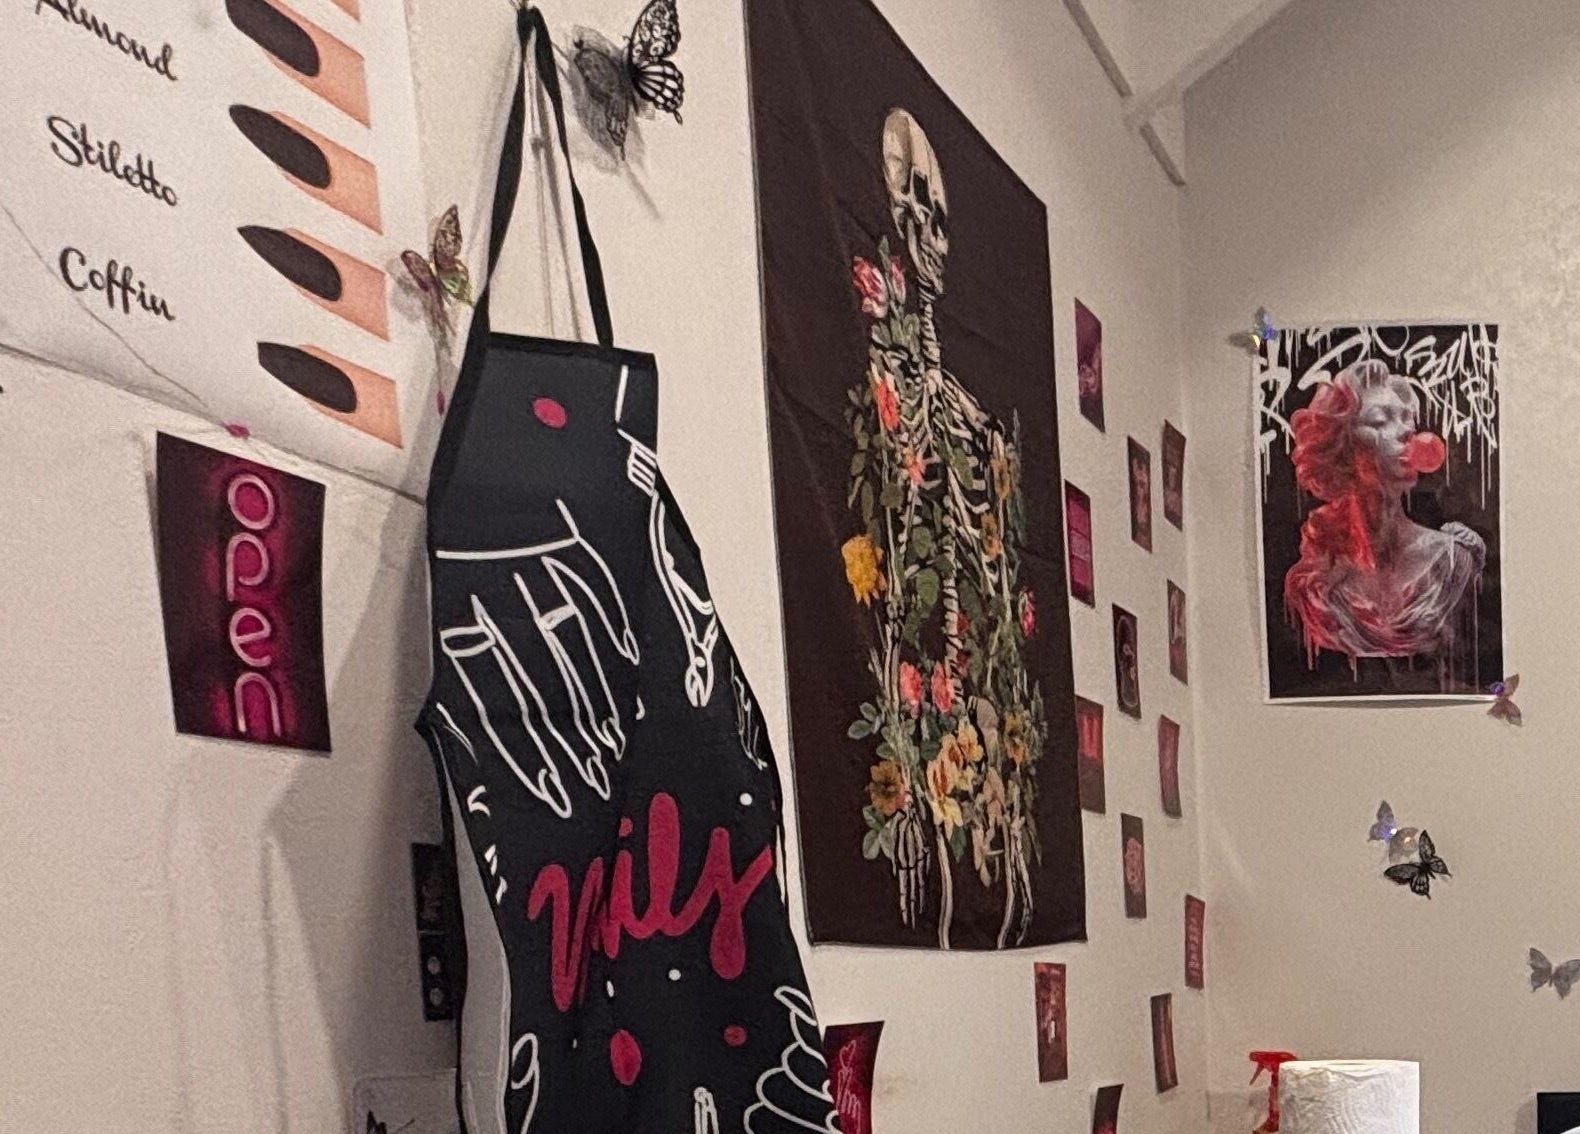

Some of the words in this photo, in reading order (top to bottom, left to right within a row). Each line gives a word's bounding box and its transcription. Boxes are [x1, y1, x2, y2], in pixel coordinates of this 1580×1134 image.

[46, 115, 178, 207] Stiletto
[58, 246, 176, 322] Coffin
[226, 473, 282, 738] open
